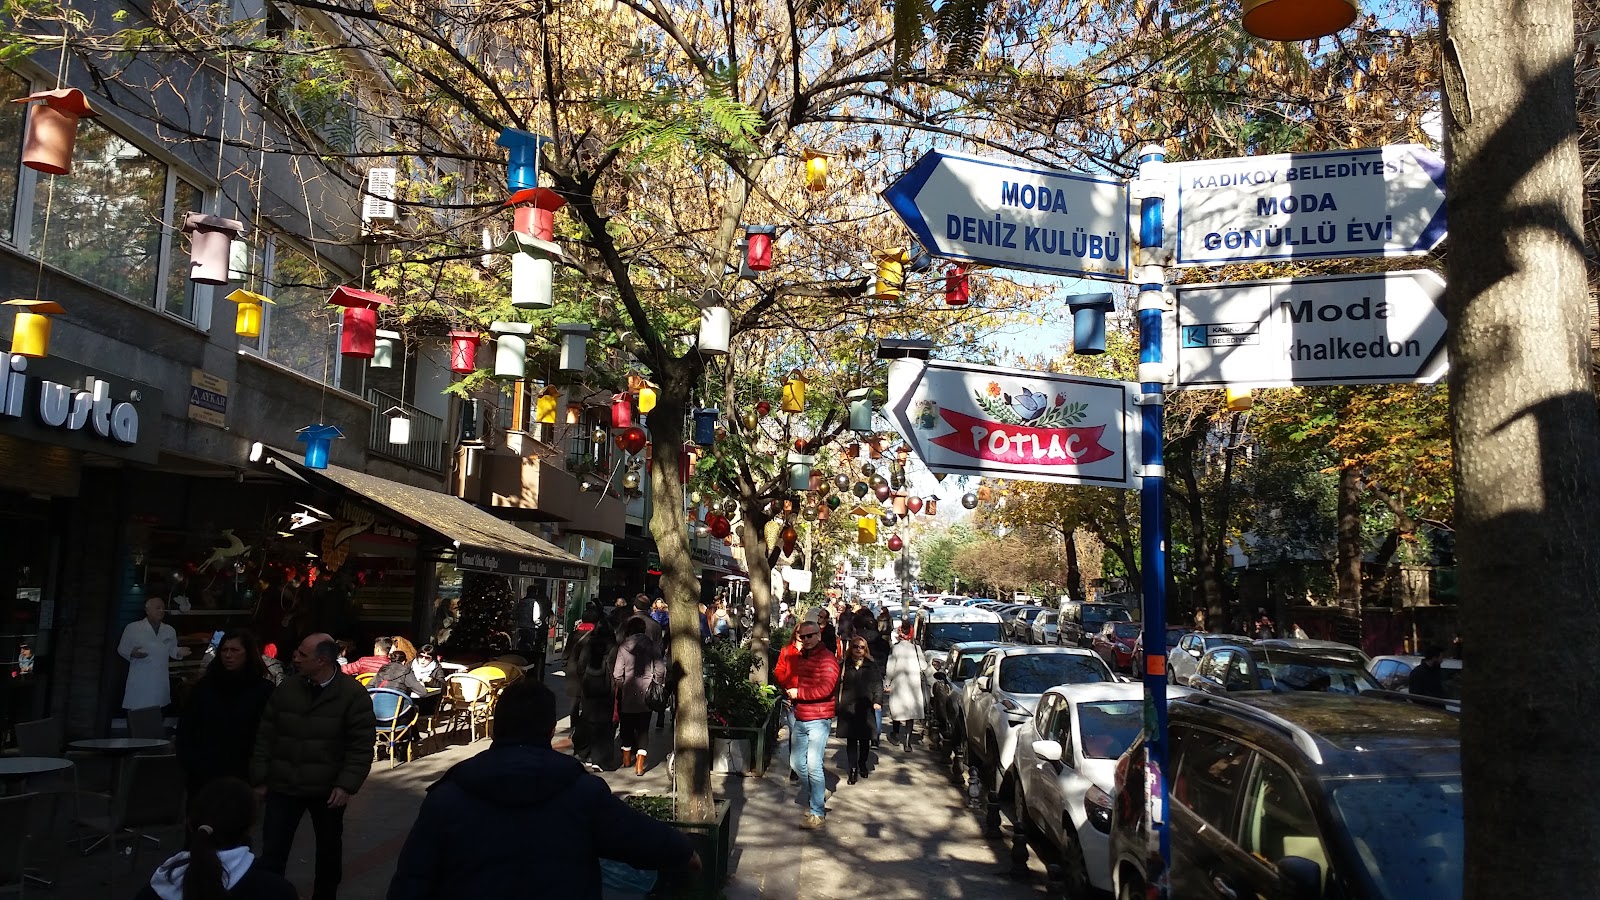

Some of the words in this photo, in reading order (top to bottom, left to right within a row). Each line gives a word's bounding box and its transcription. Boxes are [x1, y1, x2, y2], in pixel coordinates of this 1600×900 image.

[1286, 154, 1405, 182] BELEDİYESİ
[1001, 181, 1068, 215] MODA
[1257, 193, 1338, 217] MODA
[946, 213, 1017, 250] DENİZ
[1024, 226, 1120, 262] KULÜBÜ
[1204, 221, 1336, 251] GÖNÜLLÜ
[1280, 297, 1396, 324] Moda
[40, 379, 139, 443] usta
